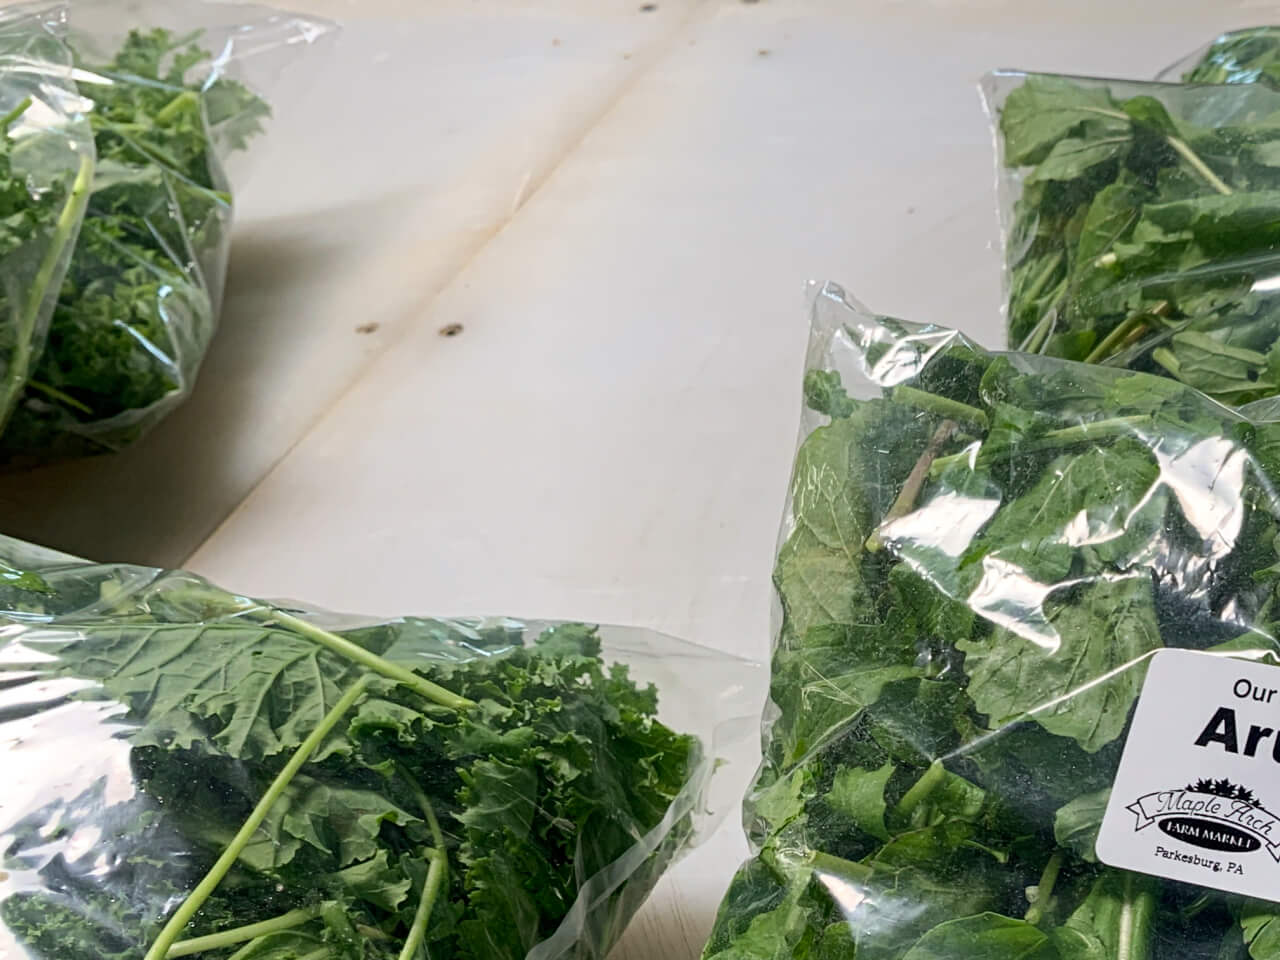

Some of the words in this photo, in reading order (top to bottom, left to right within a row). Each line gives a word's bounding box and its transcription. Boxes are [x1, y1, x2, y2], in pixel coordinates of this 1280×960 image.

[1233, 678, 1278, 704] Our
[1157, 790, 1221, 816] Maple
[1224, 799, 1276, 835] Arch
[1166, 820, 1200, 837] FARM
[1202, 830, 1254, 849] MARKET
[1227, 862, 1244, 875] PA
